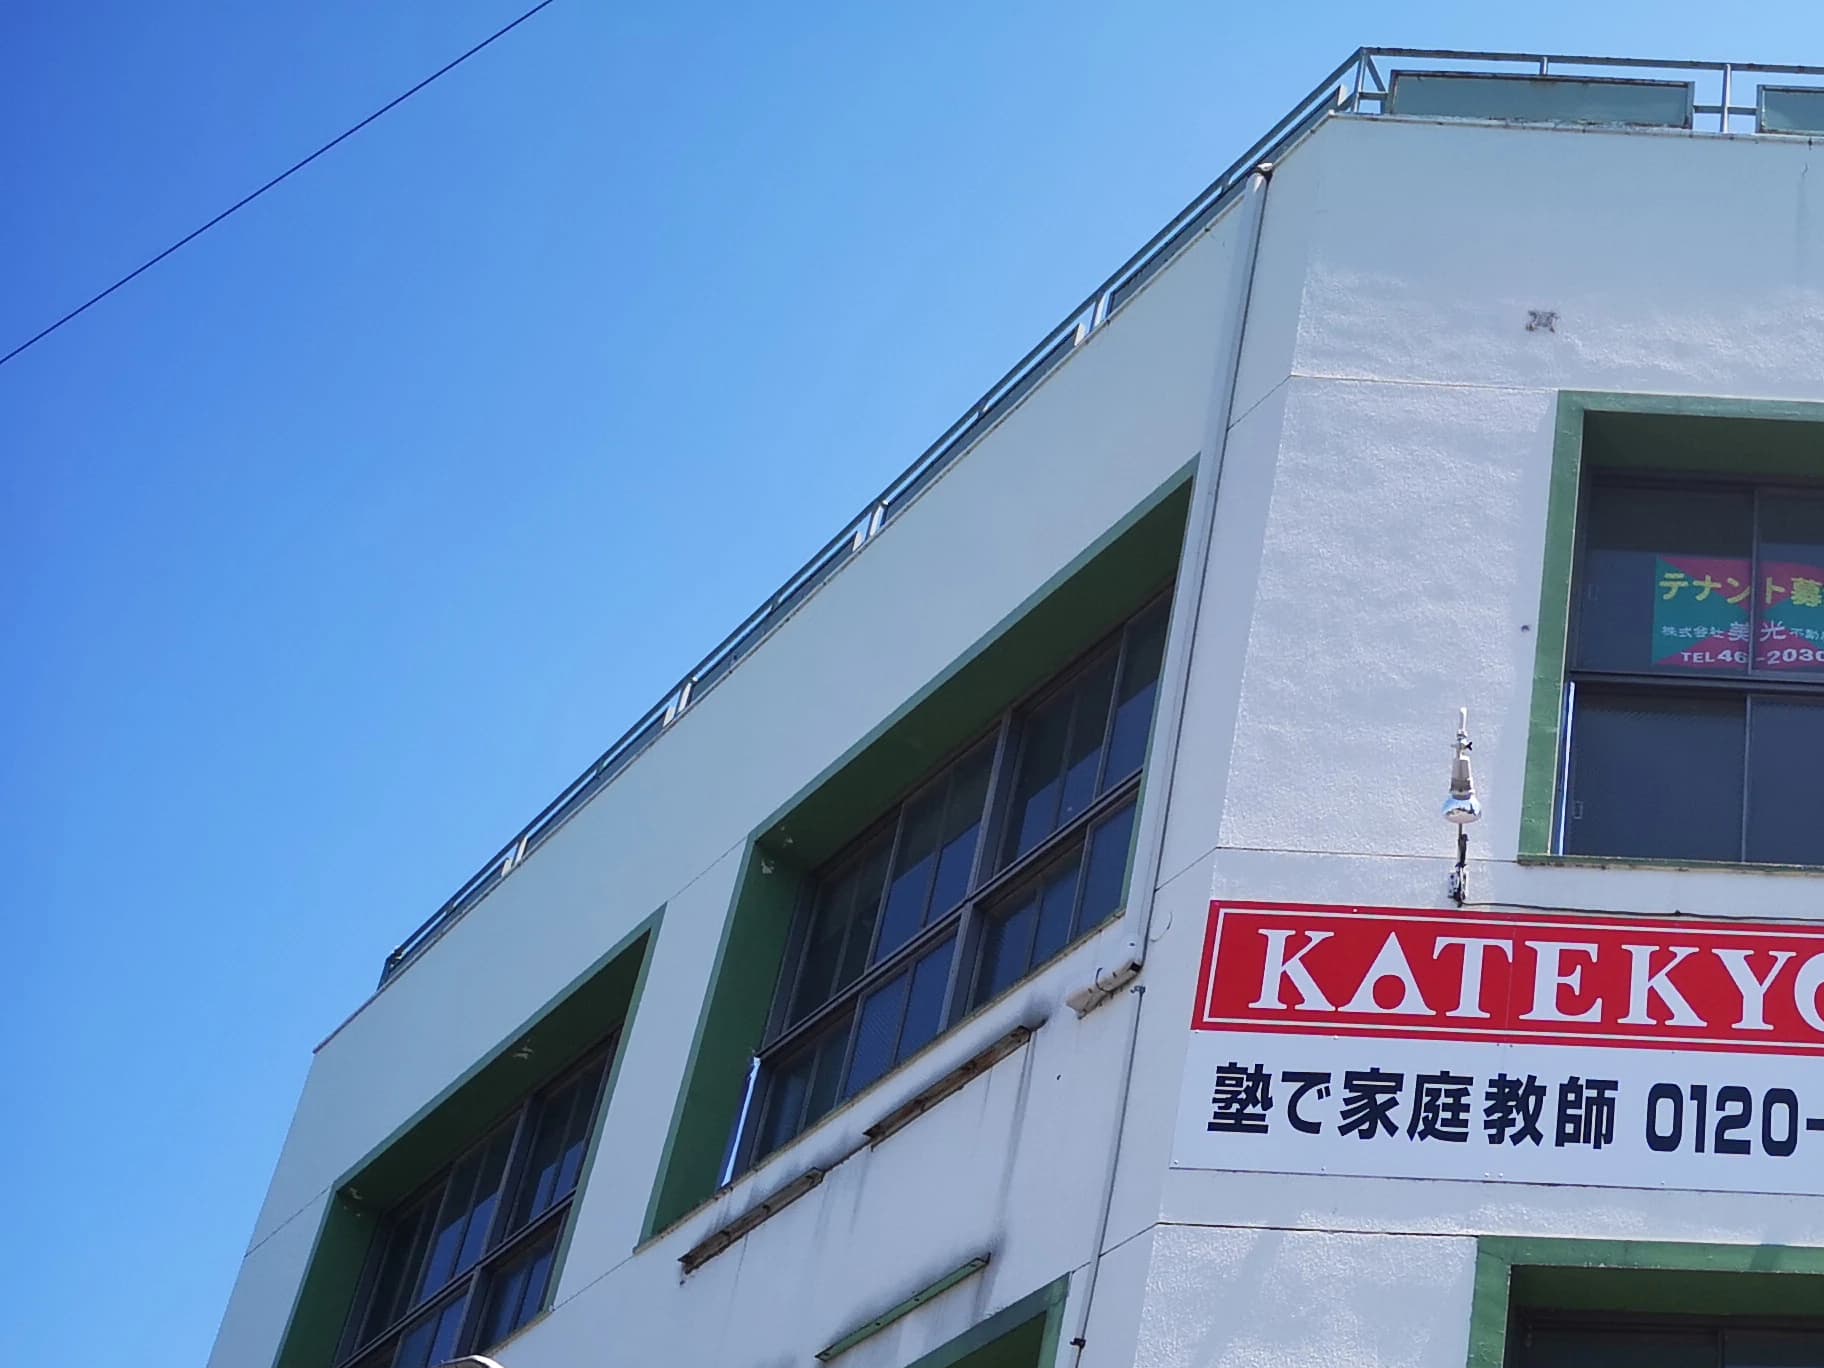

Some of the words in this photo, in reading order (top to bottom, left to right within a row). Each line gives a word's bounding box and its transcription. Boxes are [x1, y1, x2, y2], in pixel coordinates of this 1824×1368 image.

[1207, 1060, 1620, 1151] 塾で家庭教師
